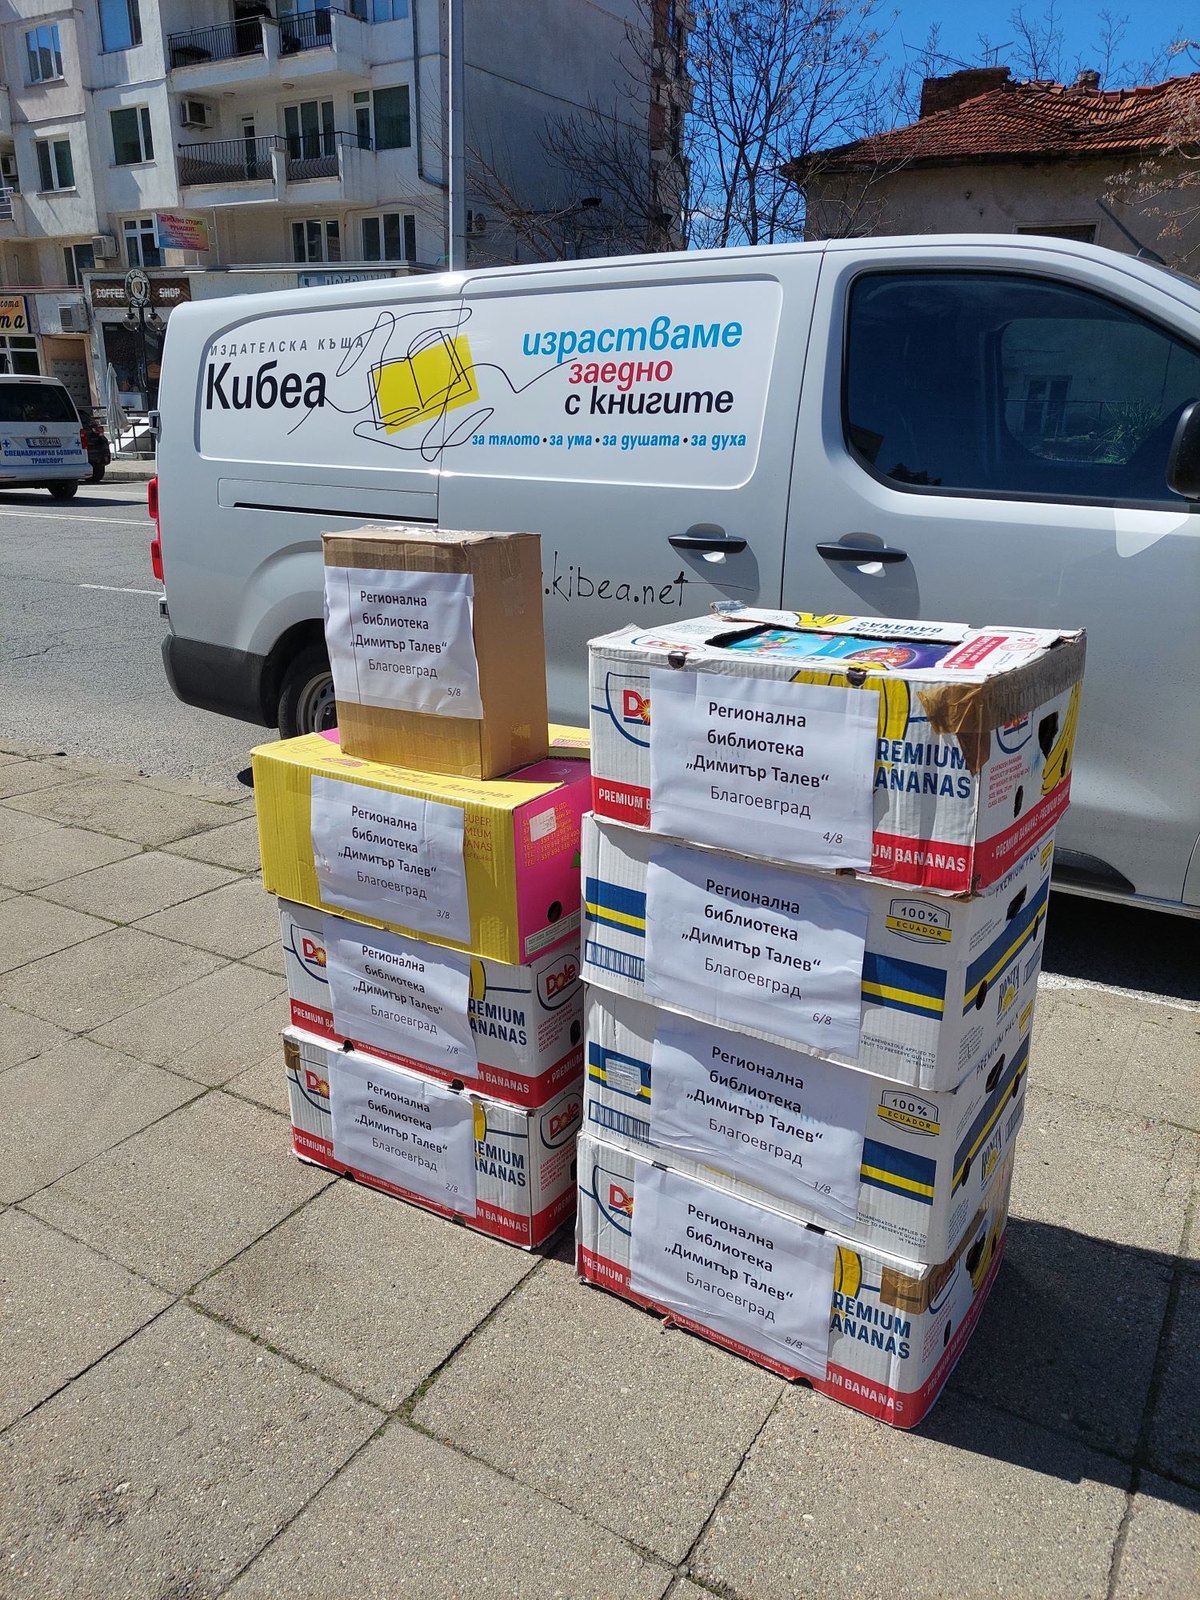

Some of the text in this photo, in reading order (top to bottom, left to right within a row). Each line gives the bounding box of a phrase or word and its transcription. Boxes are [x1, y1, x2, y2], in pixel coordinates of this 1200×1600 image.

[96, 287, 181, 298] COFFEE SHOP
[210, 339, 308, 356] ИЗДАТЕЛСКА
[522, 315, 743, 363] израстваме
[206, 360, 327, 410] Кибеа
[568, 360, 673, 391] заедно
[564, 386, 734, 415] с книгите
[472, 434, 747, 450] за тялото за ума за душата за духа
[360, 589, 428, 607] Регионална
[362, 612, 430, 631] библиотека
[350, 633, 406, 653] „Димитър
[368, 658, 438, 680] Благоевград
[447, 687, 461, 698] 5/8
[708, 701, 807, 729] Регионална
[707, 729, 804, 757] библиотека
[877, 738, 969, 771] REMIUM
[686, 754, 767, 782] „Димитър
[875, 766, 971, 799] ANANAS
[599, 788, 643, 809] PREMIUM
[710, 785, 811, 820] Благоевград
[351, 805, 417, 832] Регионална
[351, 826, 418, 854] библиотека
[464, 827, 492, 840] MIUM
[464, 839, 493, 852] ANAS
[823, 832, 843, 844] 4/8
[338, 847, 395, 870] „Димитър
[895, 848, 966, 872] BANANAS
[356, 871, 427, 900] Благоевград
[706, 878, 800, 914] Регионална
[436, 909, 450, 920] 3/8
[704, 904, 799, 941] библиотека
[896, 920, 942, 937] ECUADOR
[901, 907, 938, 923] 100%
[681, 926, 761, 957] „Димитър
[361, 945, 425, 973] Регионална
[365, 964, 425, 993] библиотека
[546, 962, 577, 997] Dole
[704, 957, 802, 1000] Благоевград
[353, 981, 407, 1006] „Димитър
[293, 1006, 324, 1028] PREMIUM
[370, 1005, 438, 1035] Благоевград
[468, 998, 526, 1028] REMIUM
[812, 1012, 832, 1025] 6/8
[470, 1017, 528, 1046] ANANAS
[863, 1035, 904, 1051] THIABENDAZOLE
[905, 1047, 927, 1056] APPLIED
[446, 1044, 459, 1055] 7/8
[884, 1046, 910, 1058] PRESERVE
[911, 1054, 936, 1063] QUALITY
[711, 1046, 804, 1090] Регионална
[912, 1060, 935, 1070] TRANSIT
[366, 1081, 430, 1113] Регионална
[485, 1073, 530, 1094] BANANAS
[709, 1070, 802, 1114] библиотека
[367, 1100, 432, 1131] библиотека
[686, 1088, 765, 1124] „Димитър
[887, 1110, 931, 1129] ECUADOR
[892, 1099, 927, 1117] 100%
[354, 1113, 409, 1141] „Димитър
[549, 1103, 579, 1138] Dole
[294, 1136, 326, 1155] PREMIUM
[372, 1137, 438, 1173] Благоевград
[475, 1140, 524, 1169] EMIUM
[709, 1118, 803, 1168] Благоевград
[475, 1157, 526, 1187] NANAS
[445, 1182, 458, 1193] 2/8
[813, 1181, 831, 1194] 1/8
[484, 1211, 528, 1233] BANANAS
[687, 1204, 775, 1250] Регионална
[858, 1212, 897, 1229] THIABENDAZOLE
[898, 1226, 918, 1236] APPLIED
[879, 1224, 903, 1237] PRESERVE
[903, 1233, 926, 1244] QUALITY
[686, 1226, 773, 1272] библиотека
[905, 1239, 926, 1249] TRANSIT
[582, 1255, 624, 1284] PREMIUM
[664, 1242, 739, 1281] „Димитър
[686, 1271, 776, 1324] Благоевград
[833, 1291, 911, 1339] REMIUM
[785, 1336, 803, 1349] 8/8
[831, 1314, 910, 1359] ANANAS
[844, 1377, 904, 1412] BANANAS
